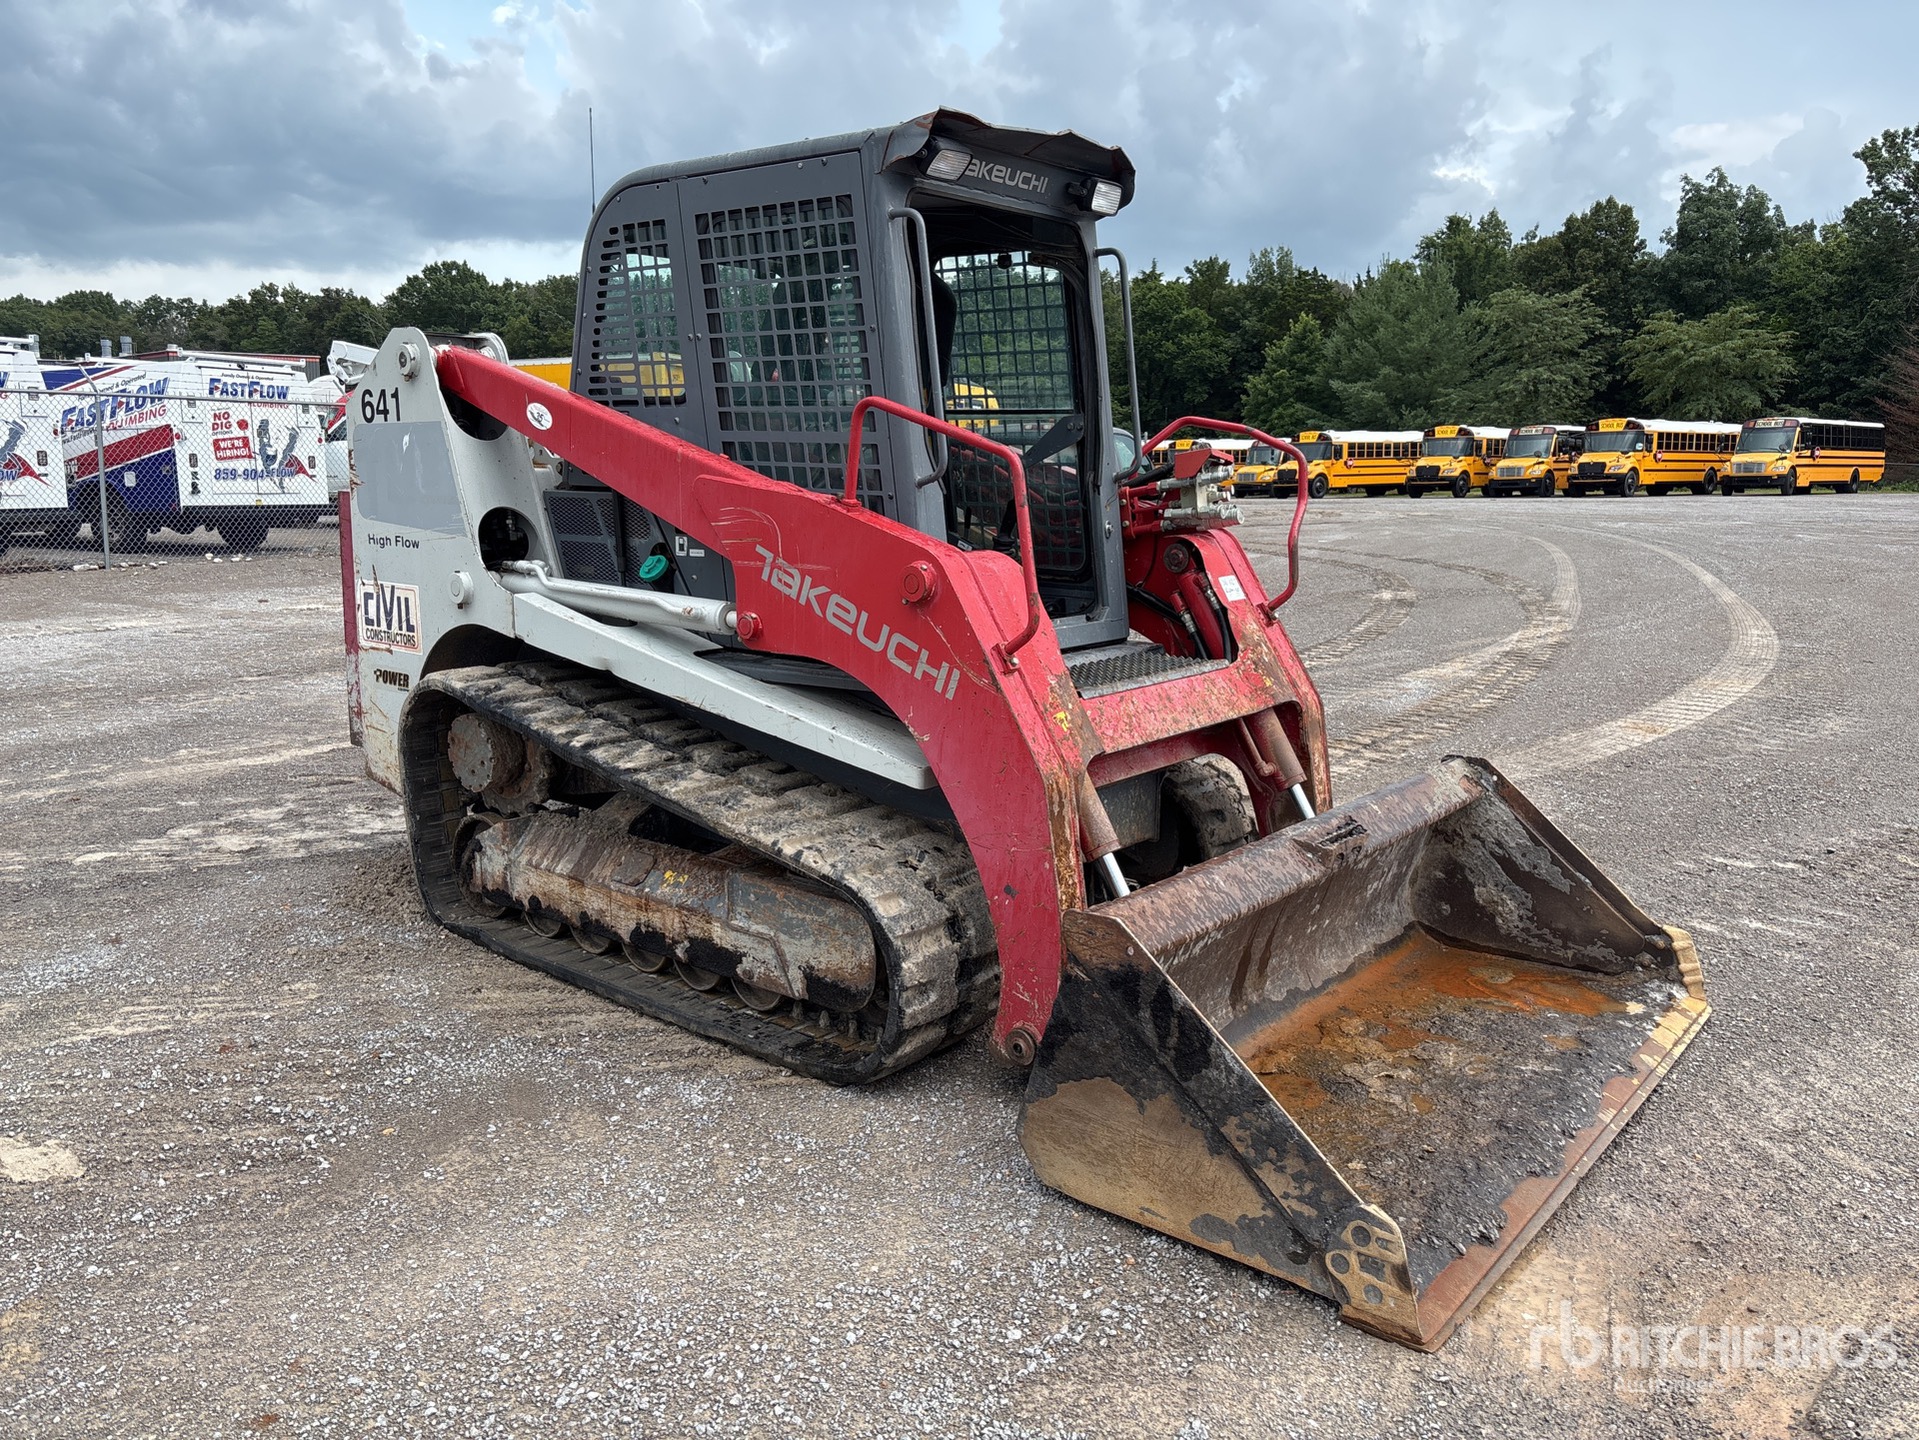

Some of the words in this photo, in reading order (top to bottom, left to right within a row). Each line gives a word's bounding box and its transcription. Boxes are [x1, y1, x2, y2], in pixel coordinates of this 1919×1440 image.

[965, 158, 1050, 194] AKEUCHI
[361, 387, 400, 423] 641
[213, 411, 231, 422] NO
[211, 421, 233, 431] DIG
[219, 439, 244, 449] WE'RE
[216, 447, 250, 459] HIRING!
[368, 533, 392, 549] High
[394, 535, 420, 549] Flow
[363, 584, 415, 633] CIVIL
[365, 628, 416, 647] CONSTRUCTORS
